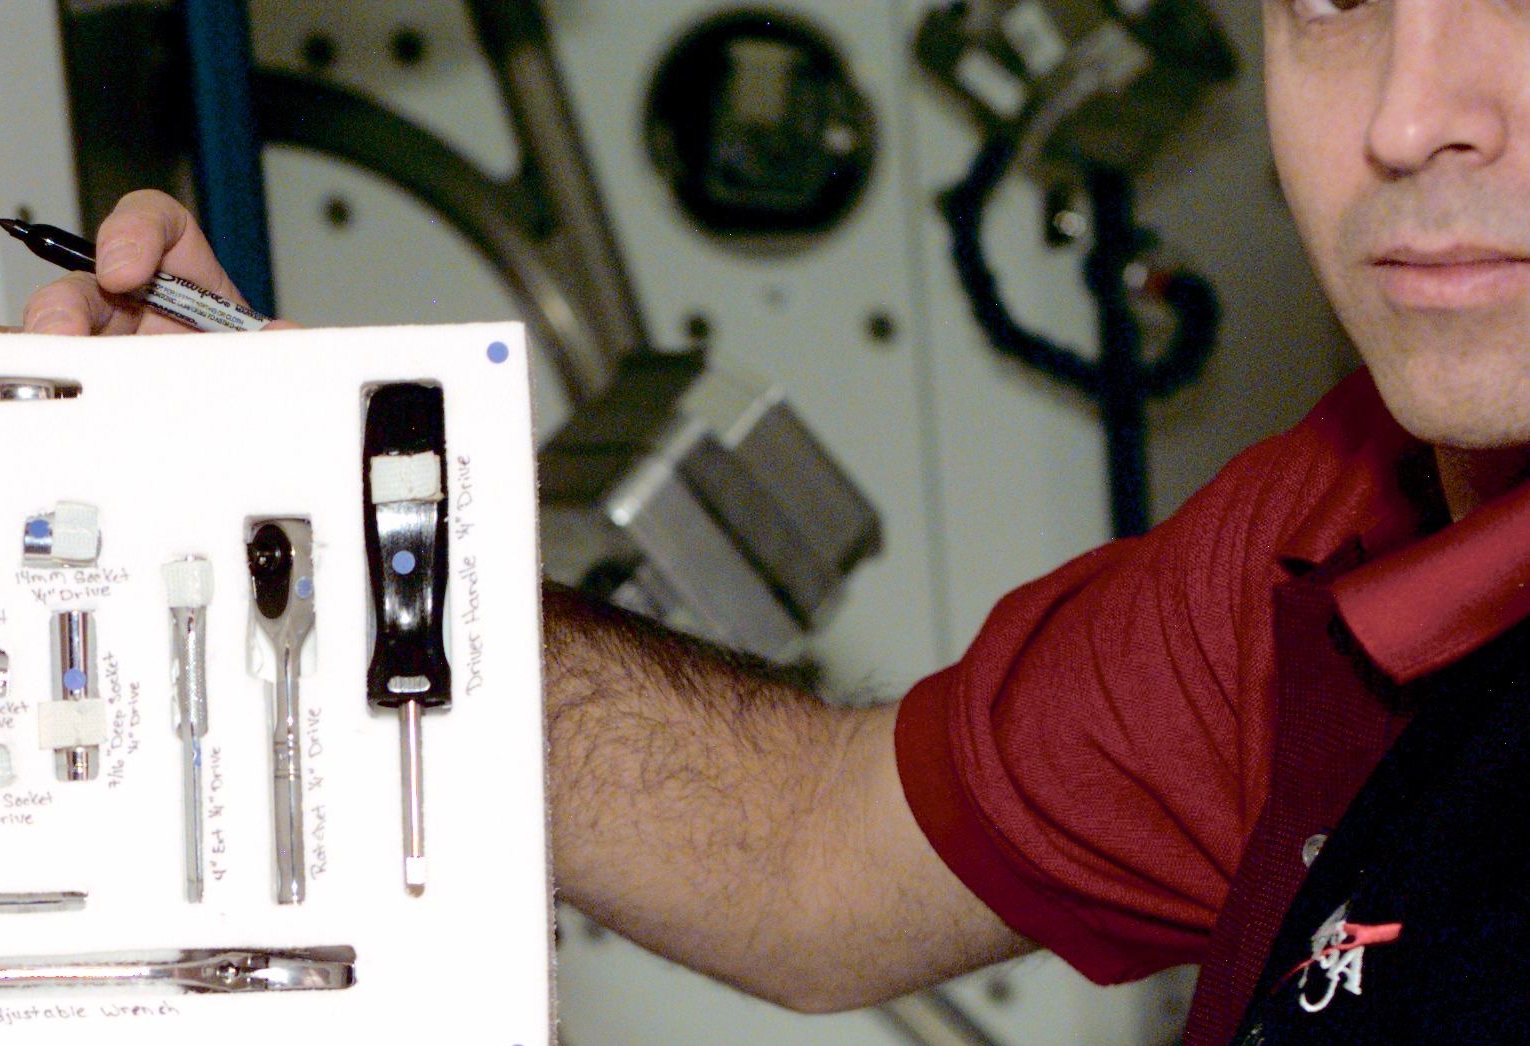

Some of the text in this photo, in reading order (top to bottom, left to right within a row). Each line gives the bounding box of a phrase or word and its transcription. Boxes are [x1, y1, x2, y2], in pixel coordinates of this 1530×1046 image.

[456, 456, 472, 511] Drive
[15, 568, 130, 584] 14mm Socket
[59, 586, 110, 602] Drive
[458, 556, 479, 625] Handle
[102, 652, 121, 705] Socket
[465, 633, 483, 696] Driver
[128, 682, 140, 728] Drive
[107, 709, 126, 752] Deep
[307, 708, 322, 759] Drive
[210, 747, 222, 792] Drive
[2, 791, 53, 808] Socket
[309, 805, 327, 880] Ratchet
